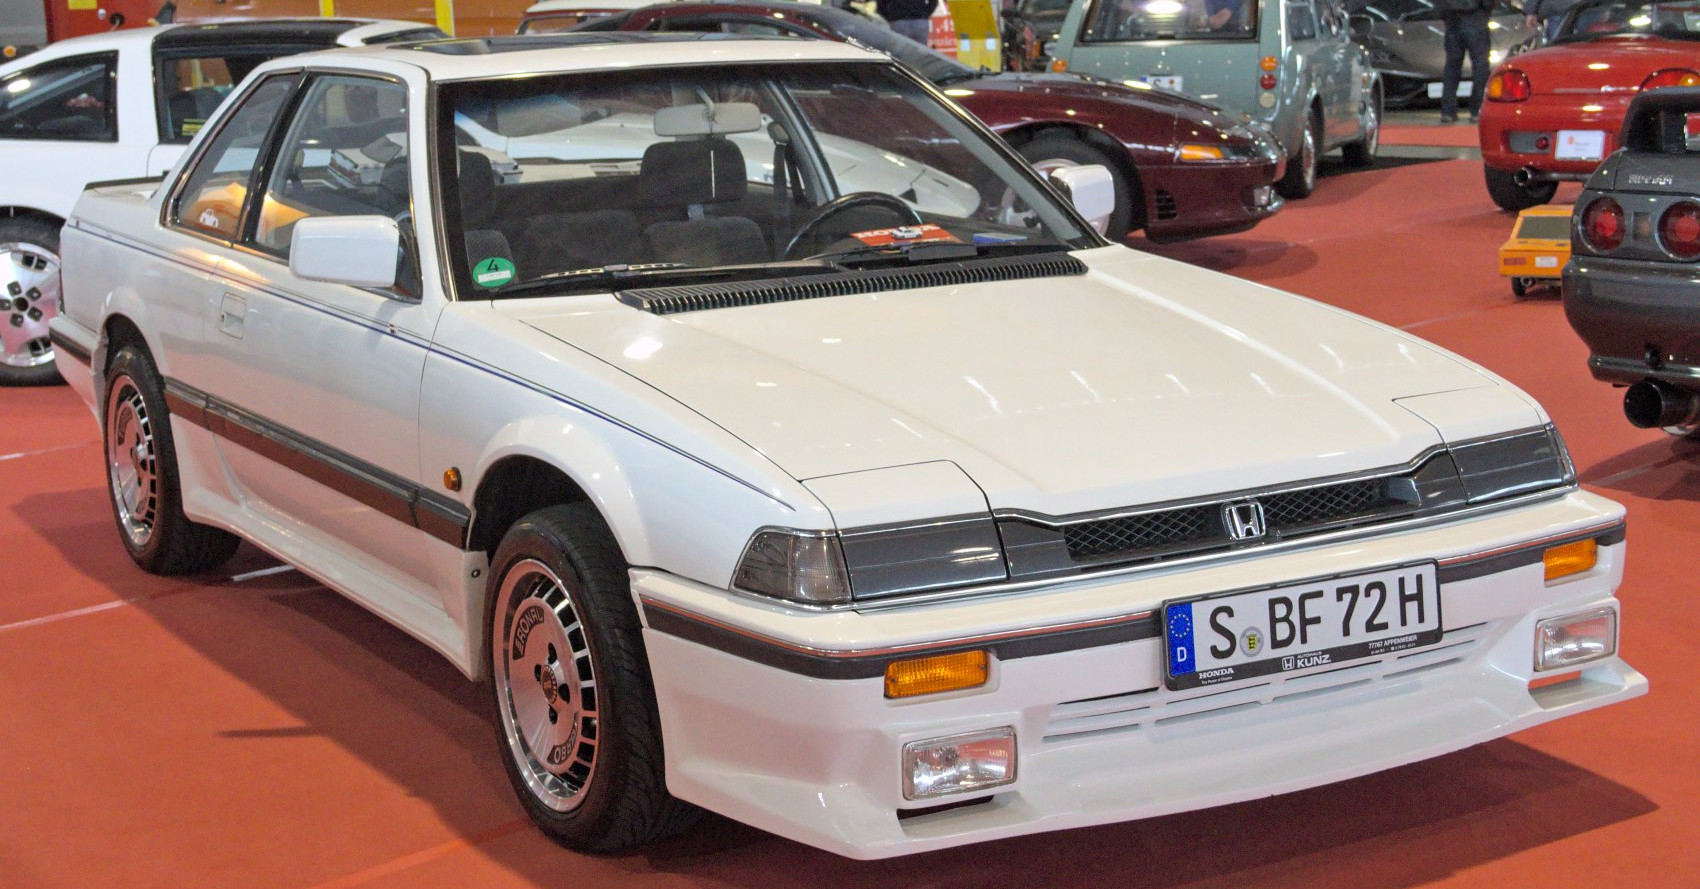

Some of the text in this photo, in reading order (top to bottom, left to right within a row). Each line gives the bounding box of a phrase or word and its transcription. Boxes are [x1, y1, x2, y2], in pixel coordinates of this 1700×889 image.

[487, 259, 500, 272] 4
[1209, 605, 1237, 659] S
[1268, 590, 1324, 650] BF
[1176, 646, 1187, 662] D
[1199, 667, 1235, 679] HONDA
